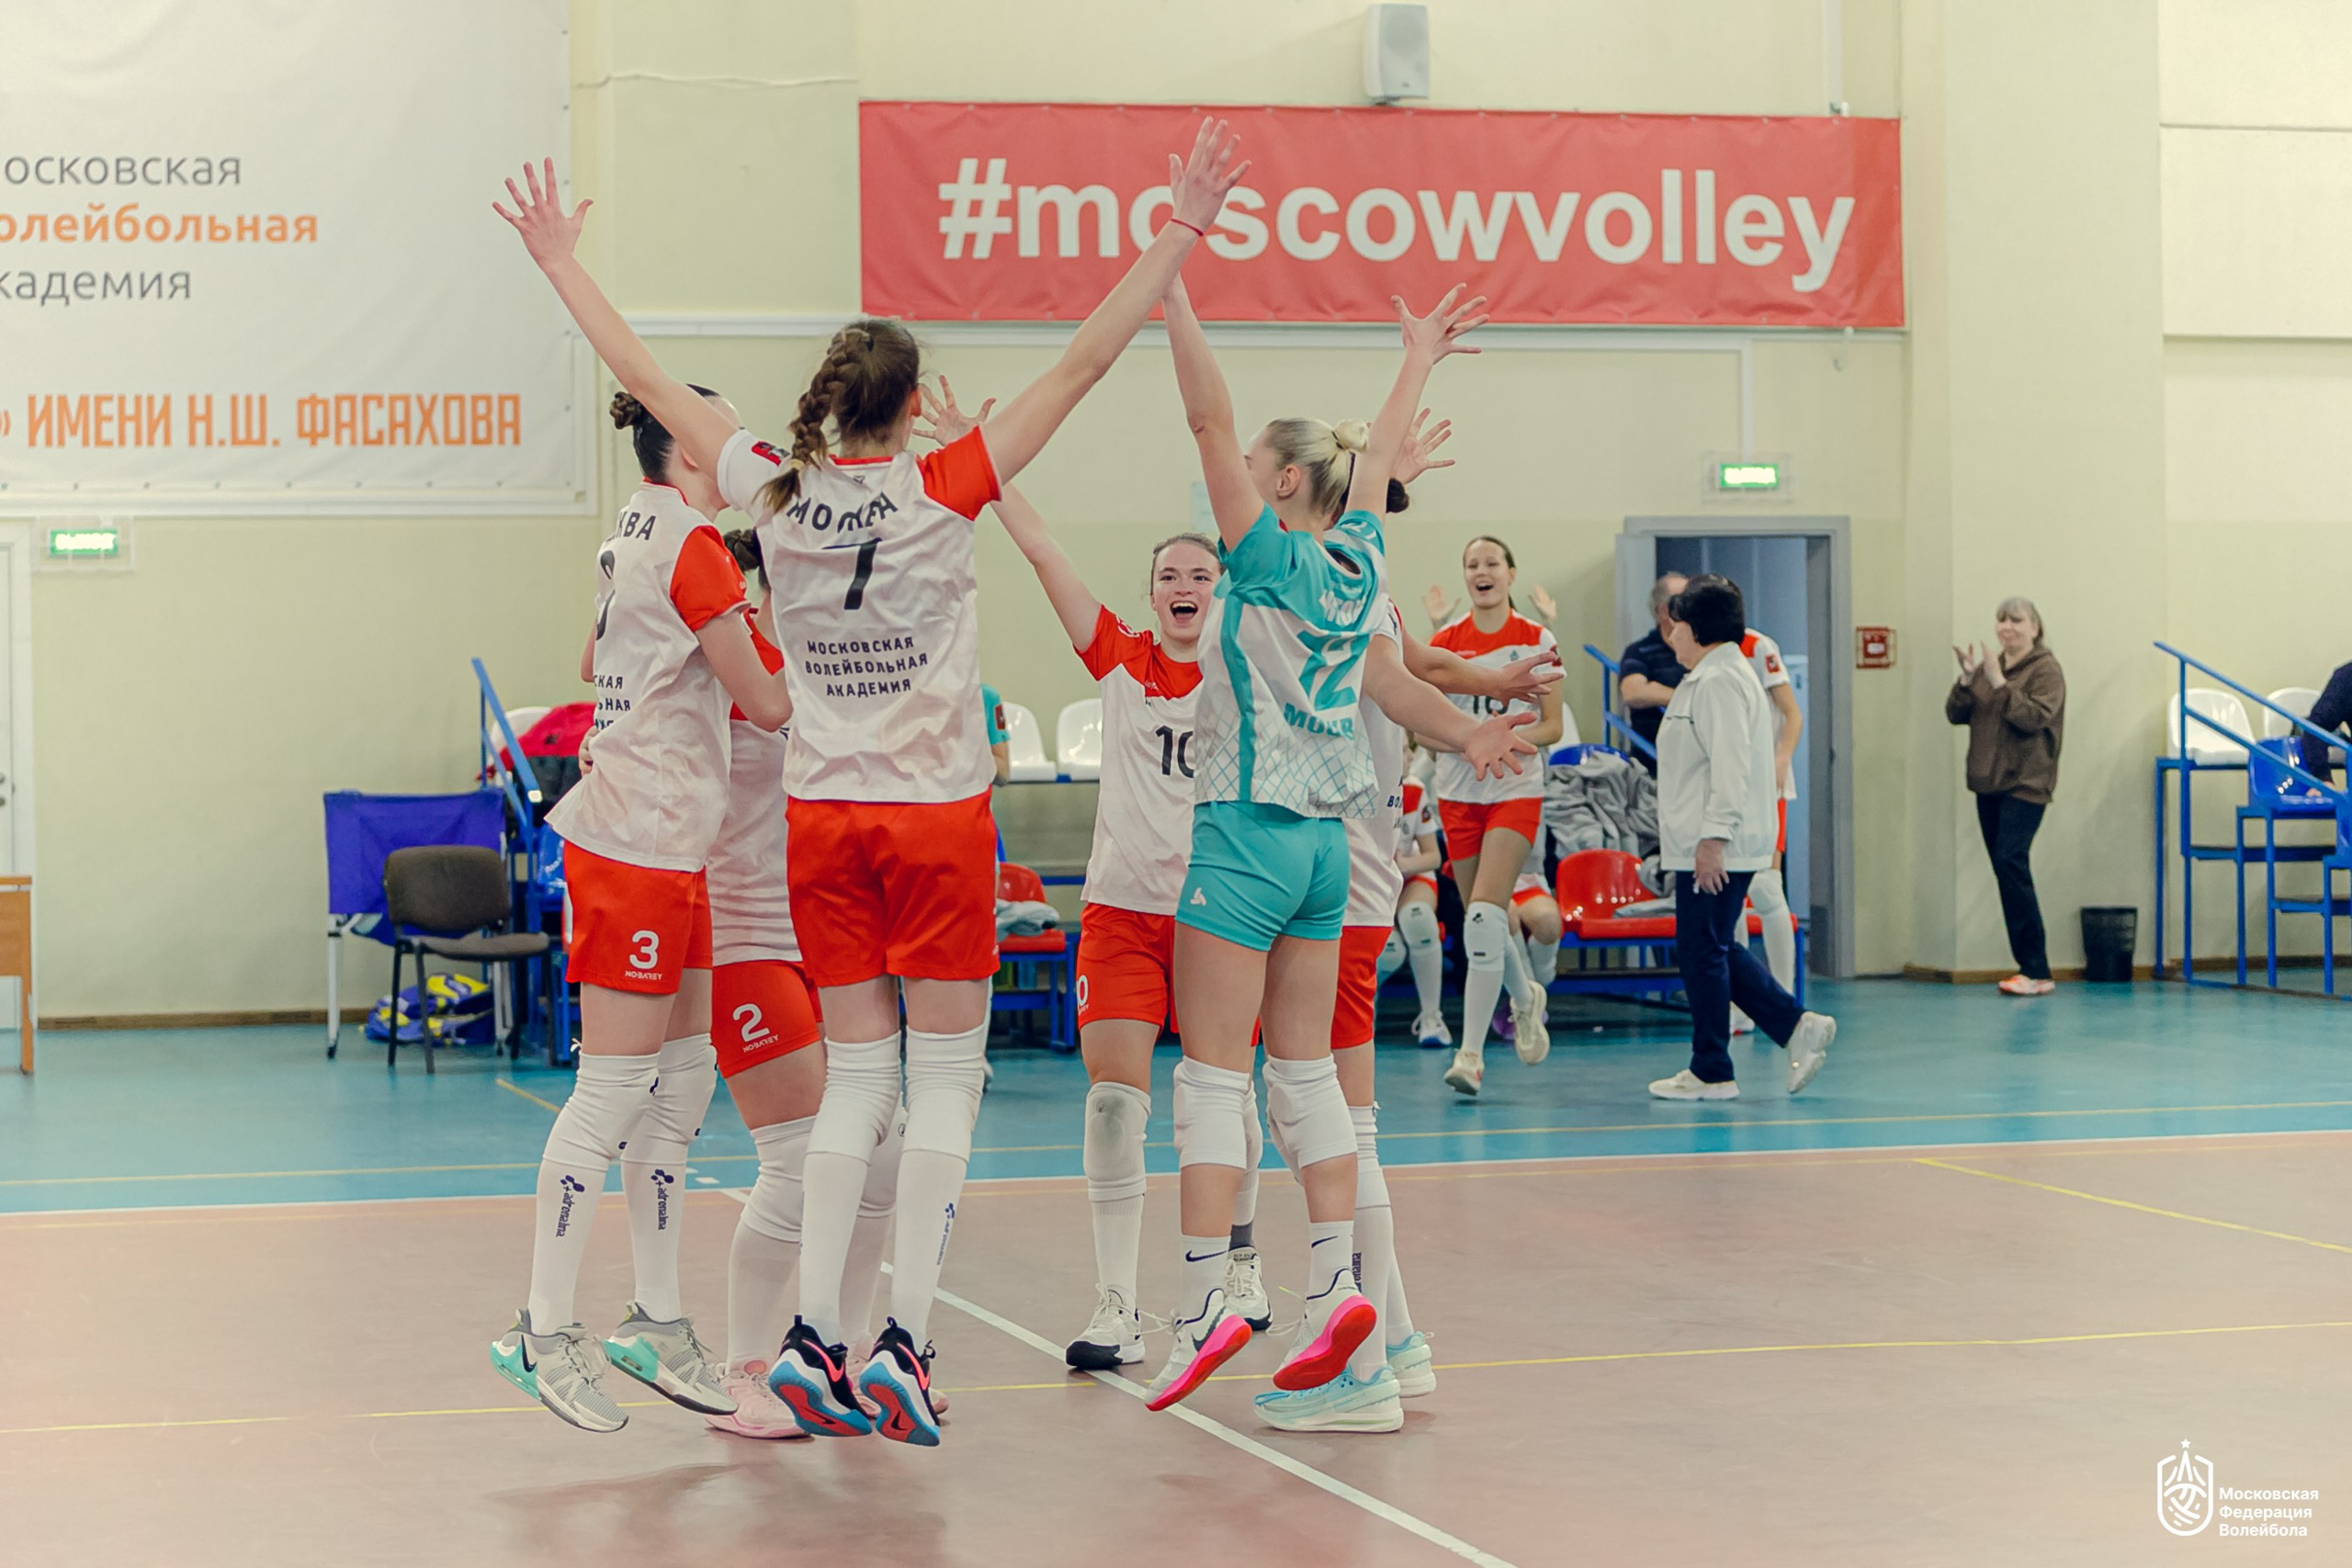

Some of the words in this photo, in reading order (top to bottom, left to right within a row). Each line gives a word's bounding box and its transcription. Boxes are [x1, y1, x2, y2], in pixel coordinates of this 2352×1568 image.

[28, 393, 172, 448] ИМЕНИ
[187, 393, 280, 447] Н.Ш.
[296, 393, 521, 447] ФАСАХОВА
[821, 536, 883, 611] 7
[807, 636, 915, 655] МОСКОВСКАЯ
[805, 653, 929, 676] ВОЛЕЙБОЛЬНАЯ
[826, 678, 912, 699] АКАДЕМИЯ
[628, 930, 660, 970] 3
[1076, 975, 1089, 1007] 0
[732, 1003, 771, 1043] 2
